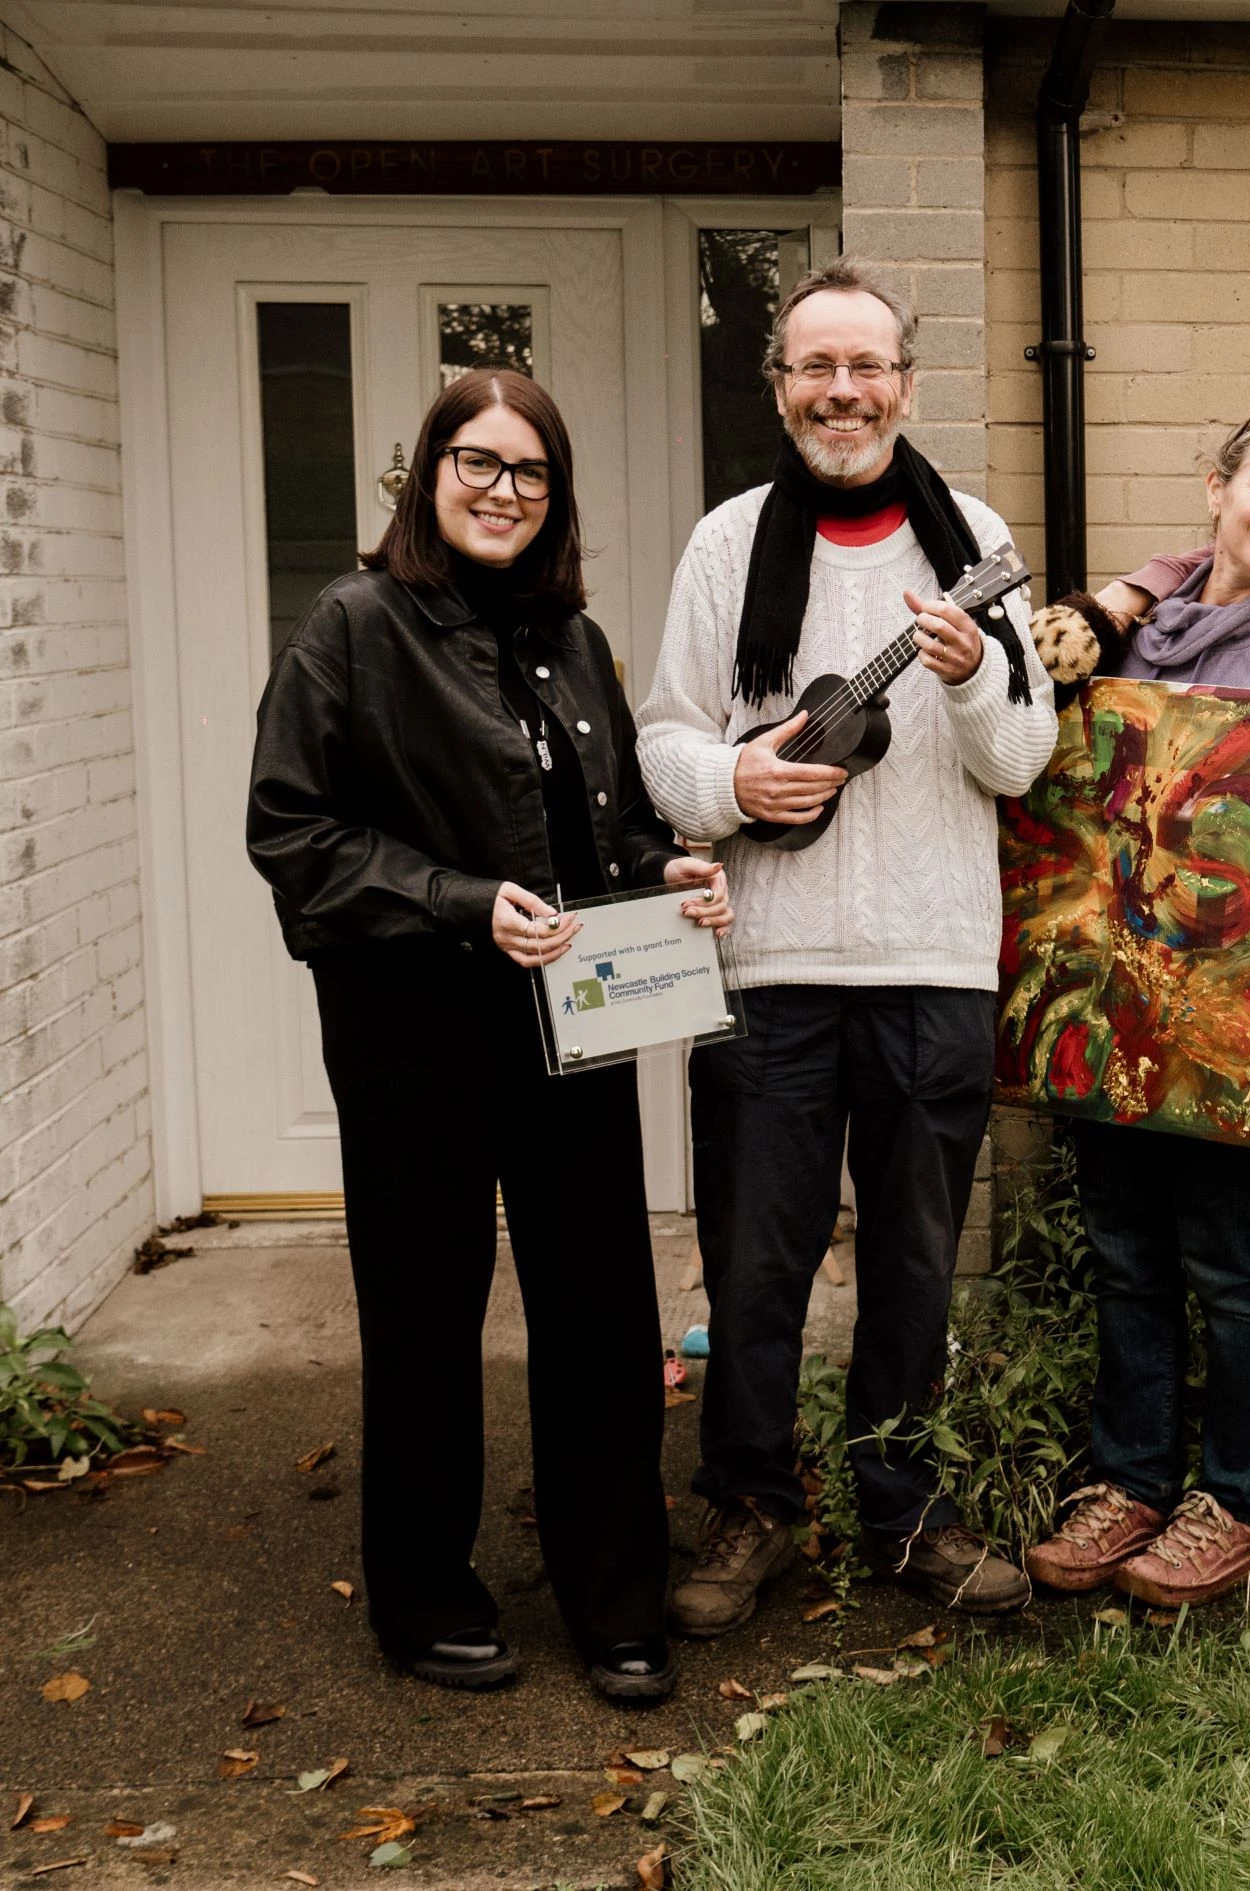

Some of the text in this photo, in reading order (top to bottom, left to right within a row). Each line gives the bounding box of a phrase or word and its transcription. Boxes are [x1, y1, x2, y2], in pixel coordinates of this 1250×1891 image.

[199, 147, 786, 181] THE OPEN ART SURGERY
[578, 949, 617, 962] Supported
[618, 945, 635, 955] with
[643, 940, 663, 952] grant
[664, 938, 682, 947] from
[607, 966, 711, 992] Newcastle Building Society
[609, 981, 674, 1000] Community Fund
